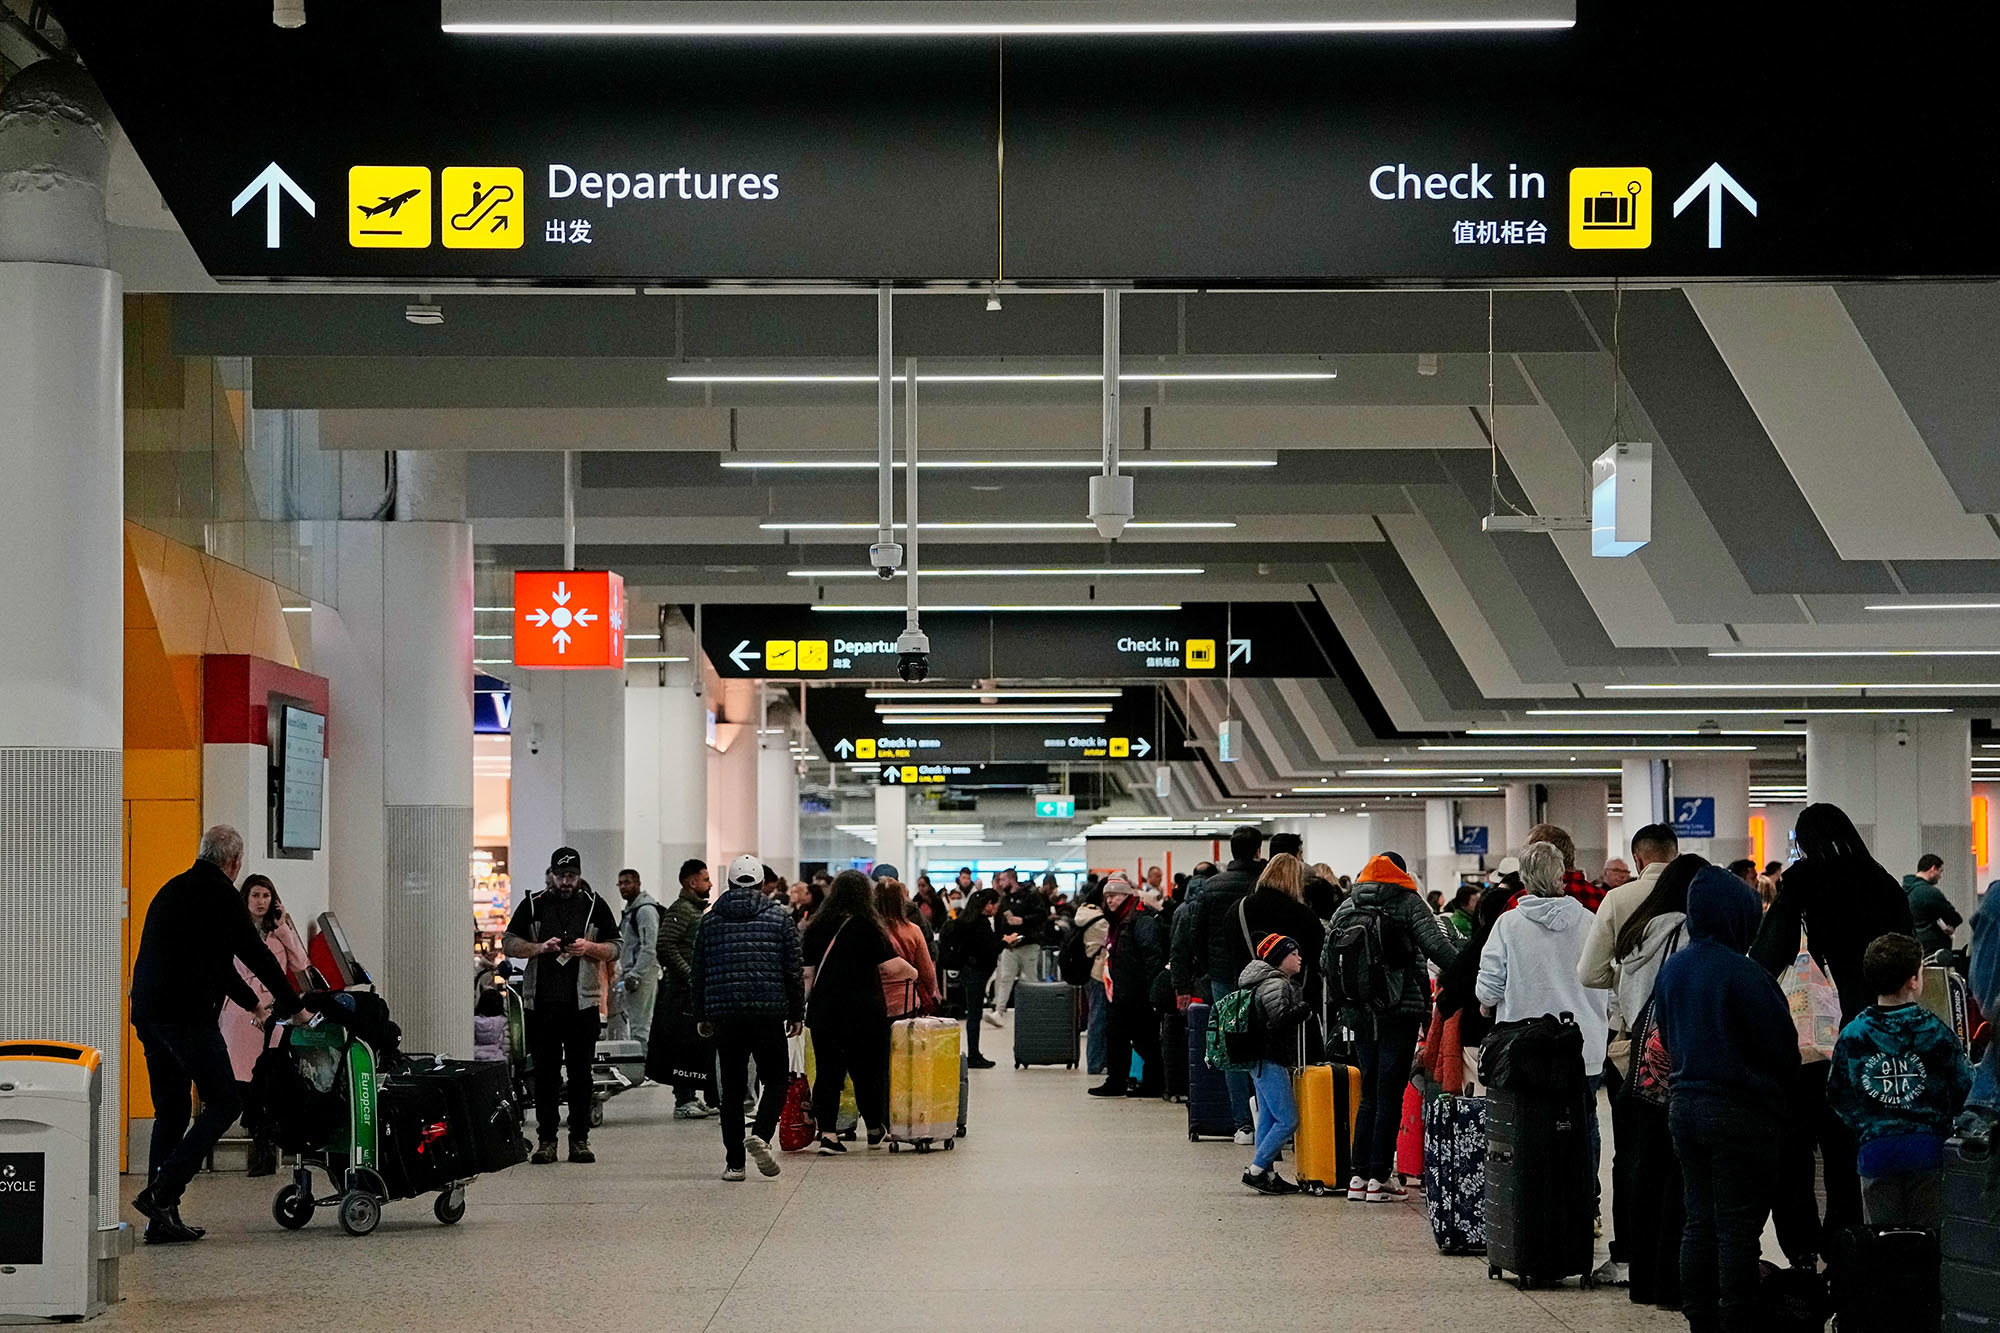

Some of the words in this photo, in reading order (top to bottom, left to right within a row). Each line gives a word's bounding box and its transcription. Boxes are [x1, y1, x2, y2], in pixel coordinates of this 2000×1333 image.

[549, 164, 780, 208] Departures
[1369, 163, 1494, 200] Check
[1509, 163, 1546, 200] in
[545, 218, 593, 244] 出发
[1452, 220, 1548, 244] 值机柜台
[1117, 637, 1161, 652] Check
[1165, 637, 1179, 652] in
[1067, 736, 1096, 747] Check
[673, 1069, 707, 1080] POLITIX
[361, 1072, 371, 1126] Europcar
[0, 1180, 37, 1192] CYCLE
